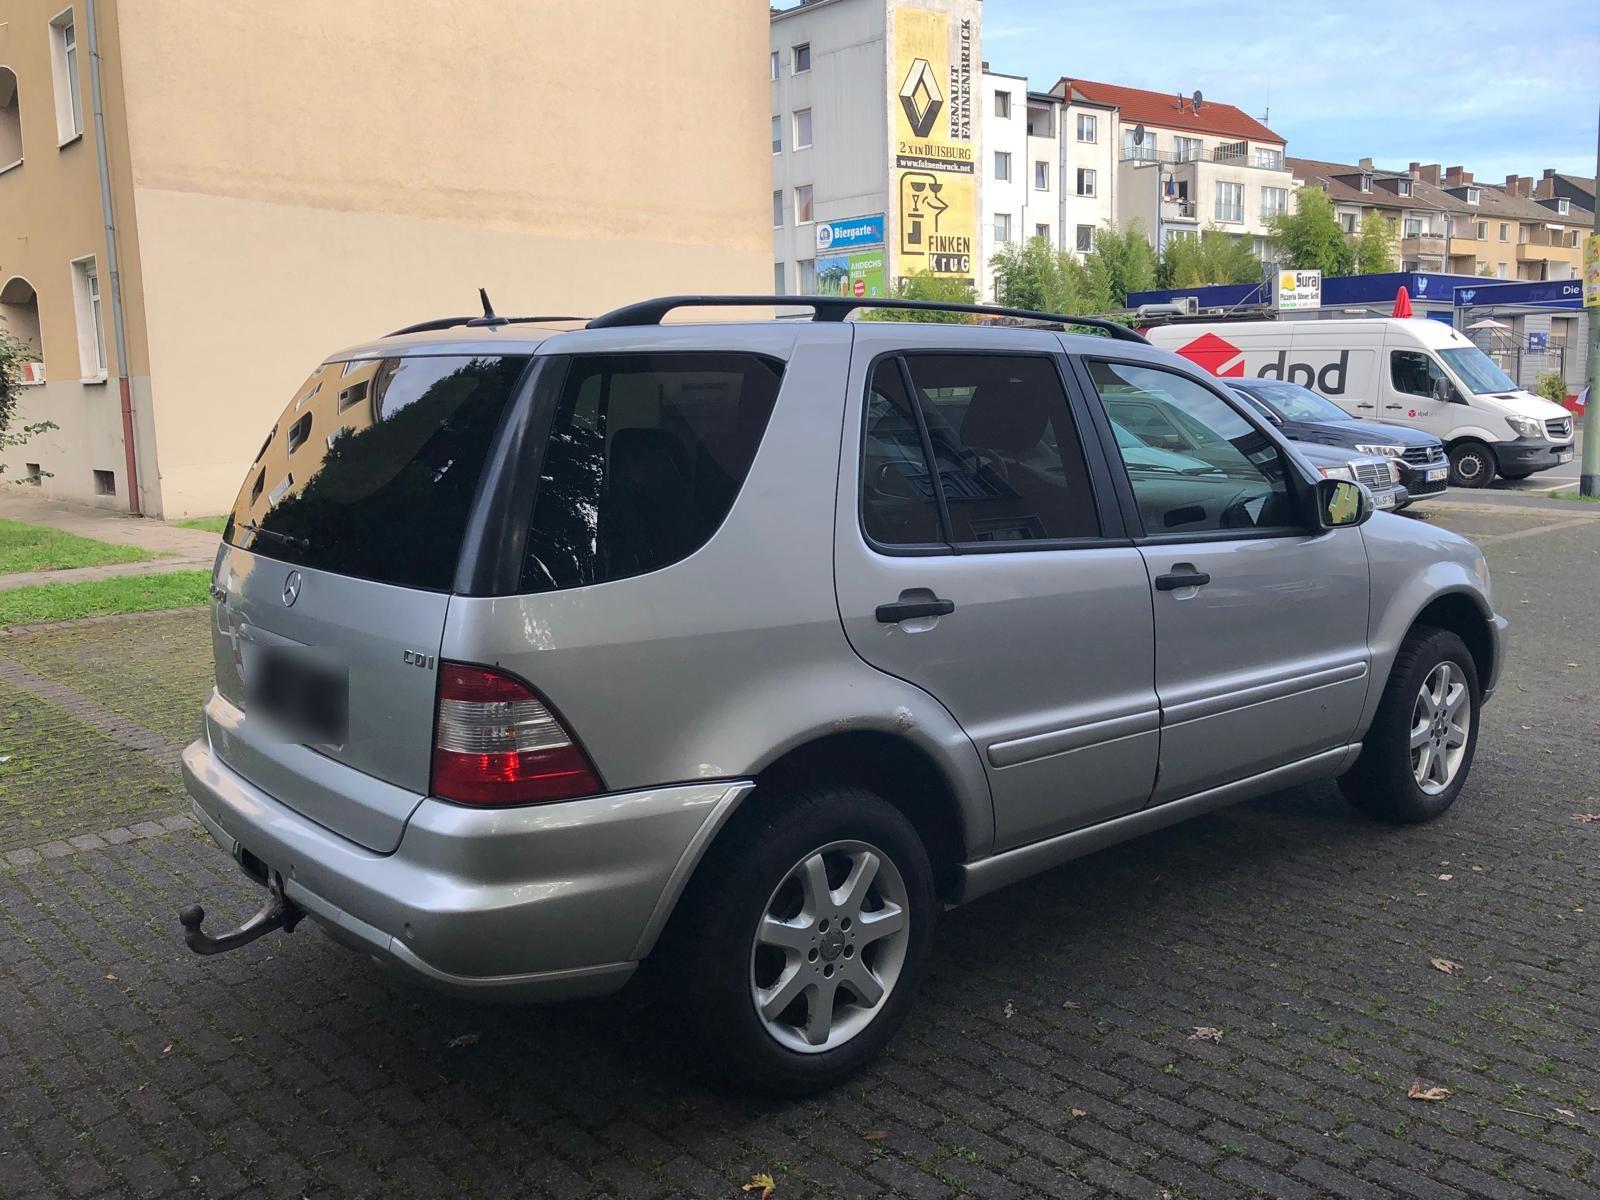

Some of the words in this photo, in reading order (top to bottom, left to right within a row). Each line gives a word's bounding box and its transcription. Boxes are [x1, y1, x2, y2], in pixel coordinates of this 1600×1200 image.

[951, 65, 959, 139] RENAULT
[900, 141, 906, 153] 2
[924, 144, 971, 160] DUISBURG
[928, 235, 970, 253] FINKEN
[1296, 272, 1320, 291] Suraj
[1563, 285, 1580, 295] Die
[1257, 349, 1349, 395] dpd
[404, 649, 434, 670] CDI
